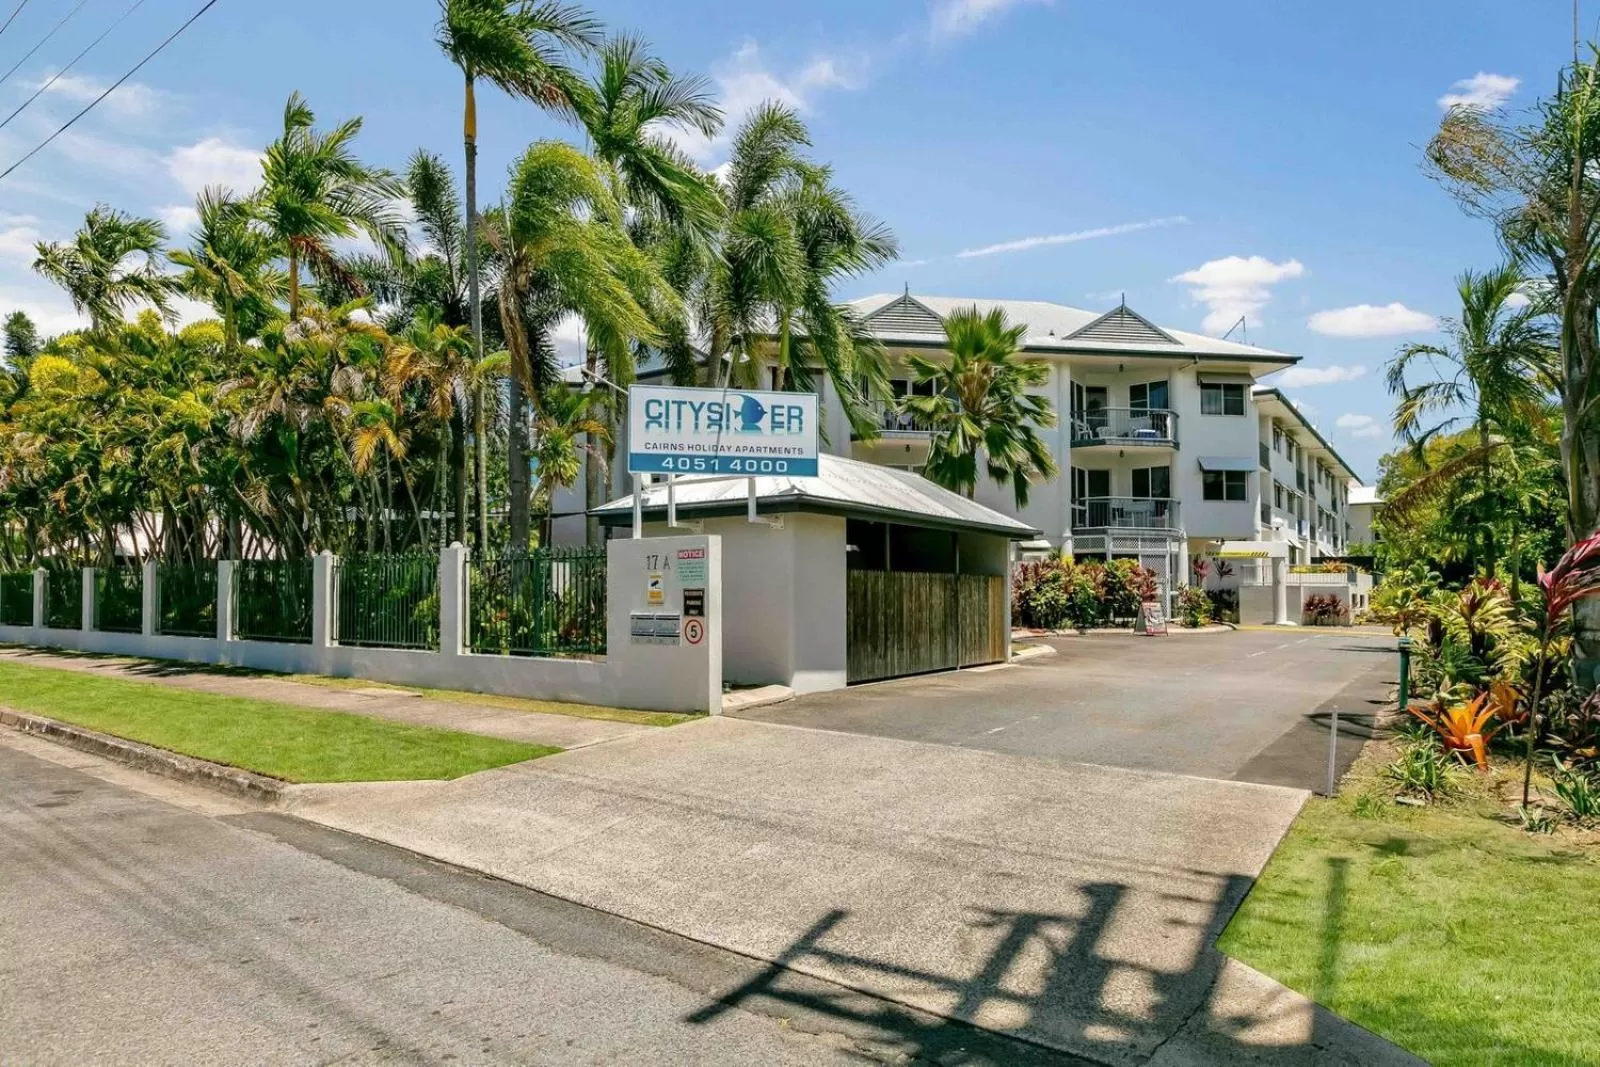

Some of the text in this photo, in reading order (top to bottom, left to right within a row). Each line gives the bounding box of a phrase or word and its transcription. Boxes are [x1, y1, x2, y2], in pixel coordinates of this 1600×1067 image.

[644, 442, 804, 455] CAIRNS HOLIDAY APARTMENTS
[661, 456, 788, 473] 4051 4000
[678, 550, 704, 558] NOTICE
[646, 554, 671, 570] 17 A
[690, 624, 698, 639] 5
